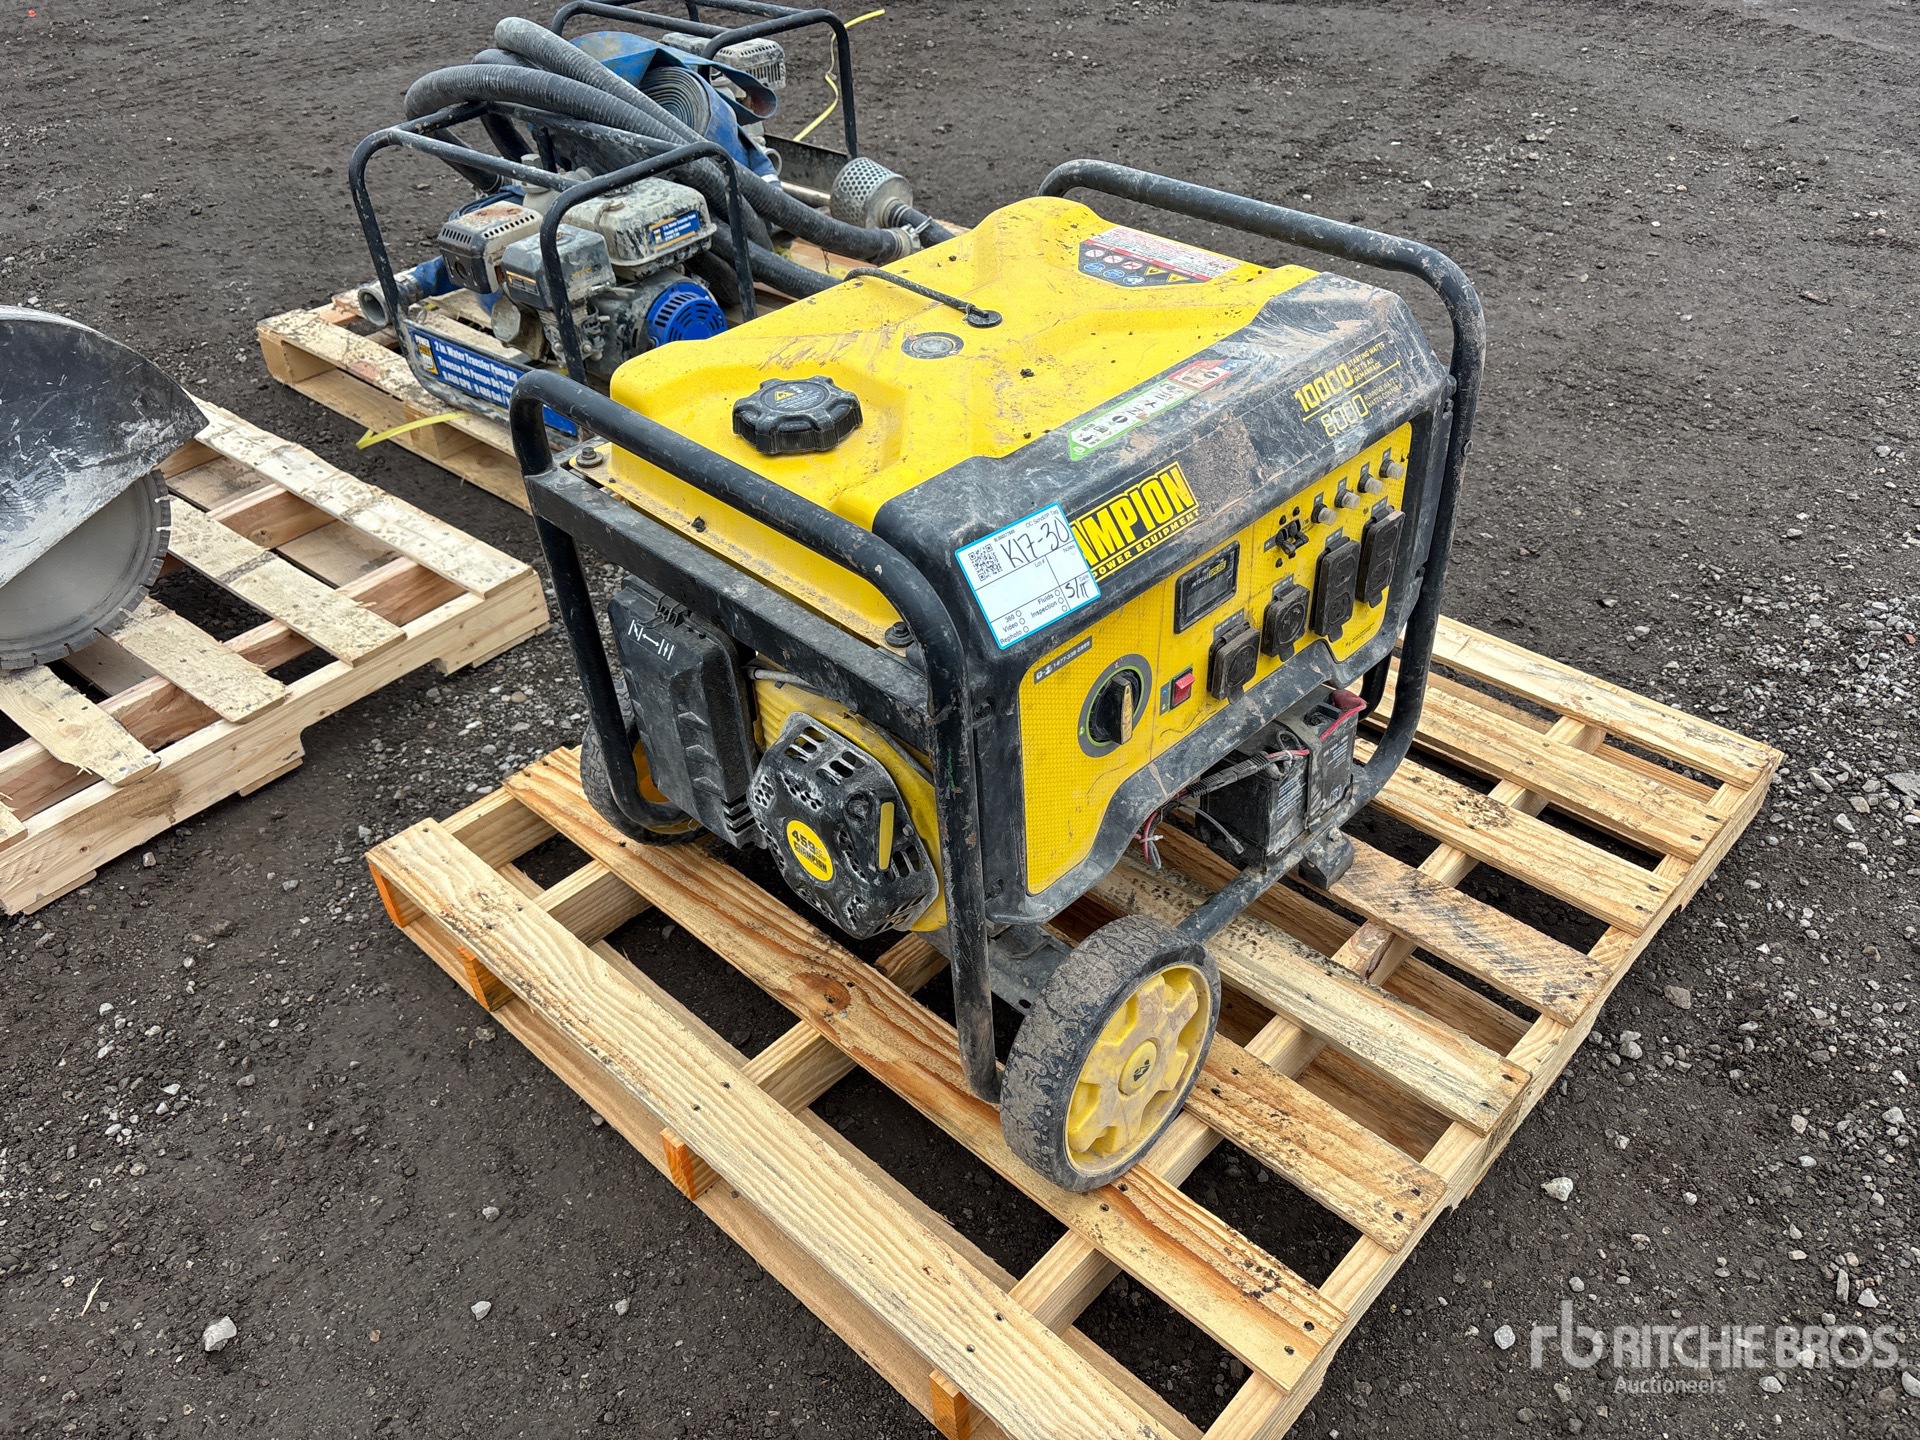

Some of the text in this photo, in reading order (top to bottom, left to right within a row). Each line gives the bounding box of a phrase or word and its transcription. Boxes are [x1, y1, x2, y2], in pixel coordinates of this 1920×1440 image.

[434, 341, 439, 351] 2
[447, 346, 465, 361] Water
[464, 353, 490, 371] Transfer
[490, 363, 509, 380] Pump
[1347, 341, 1385, 366] STARTING WATTS
[470, 369, 491, 385] Pompe
[1295, 364, 1353, 412] 10000
[1321, 394, 1368, 436] 8000
[1072, 467, 1194, 566] AMPION
[1000, 516, 1070, 568] K17-30
[1092, 510, 1200, 577] POWER EQUIPMENT
[1031, 601, 1057, 618] Inspection
[1038, 594, 1054, 604] Fluids
[1003, 622, 1018, 632] Video
[1005, 614, 1015, 623] 360
[1000, 630, 1022, 644] Rephoto
[792, 830, 815, 854] 459
